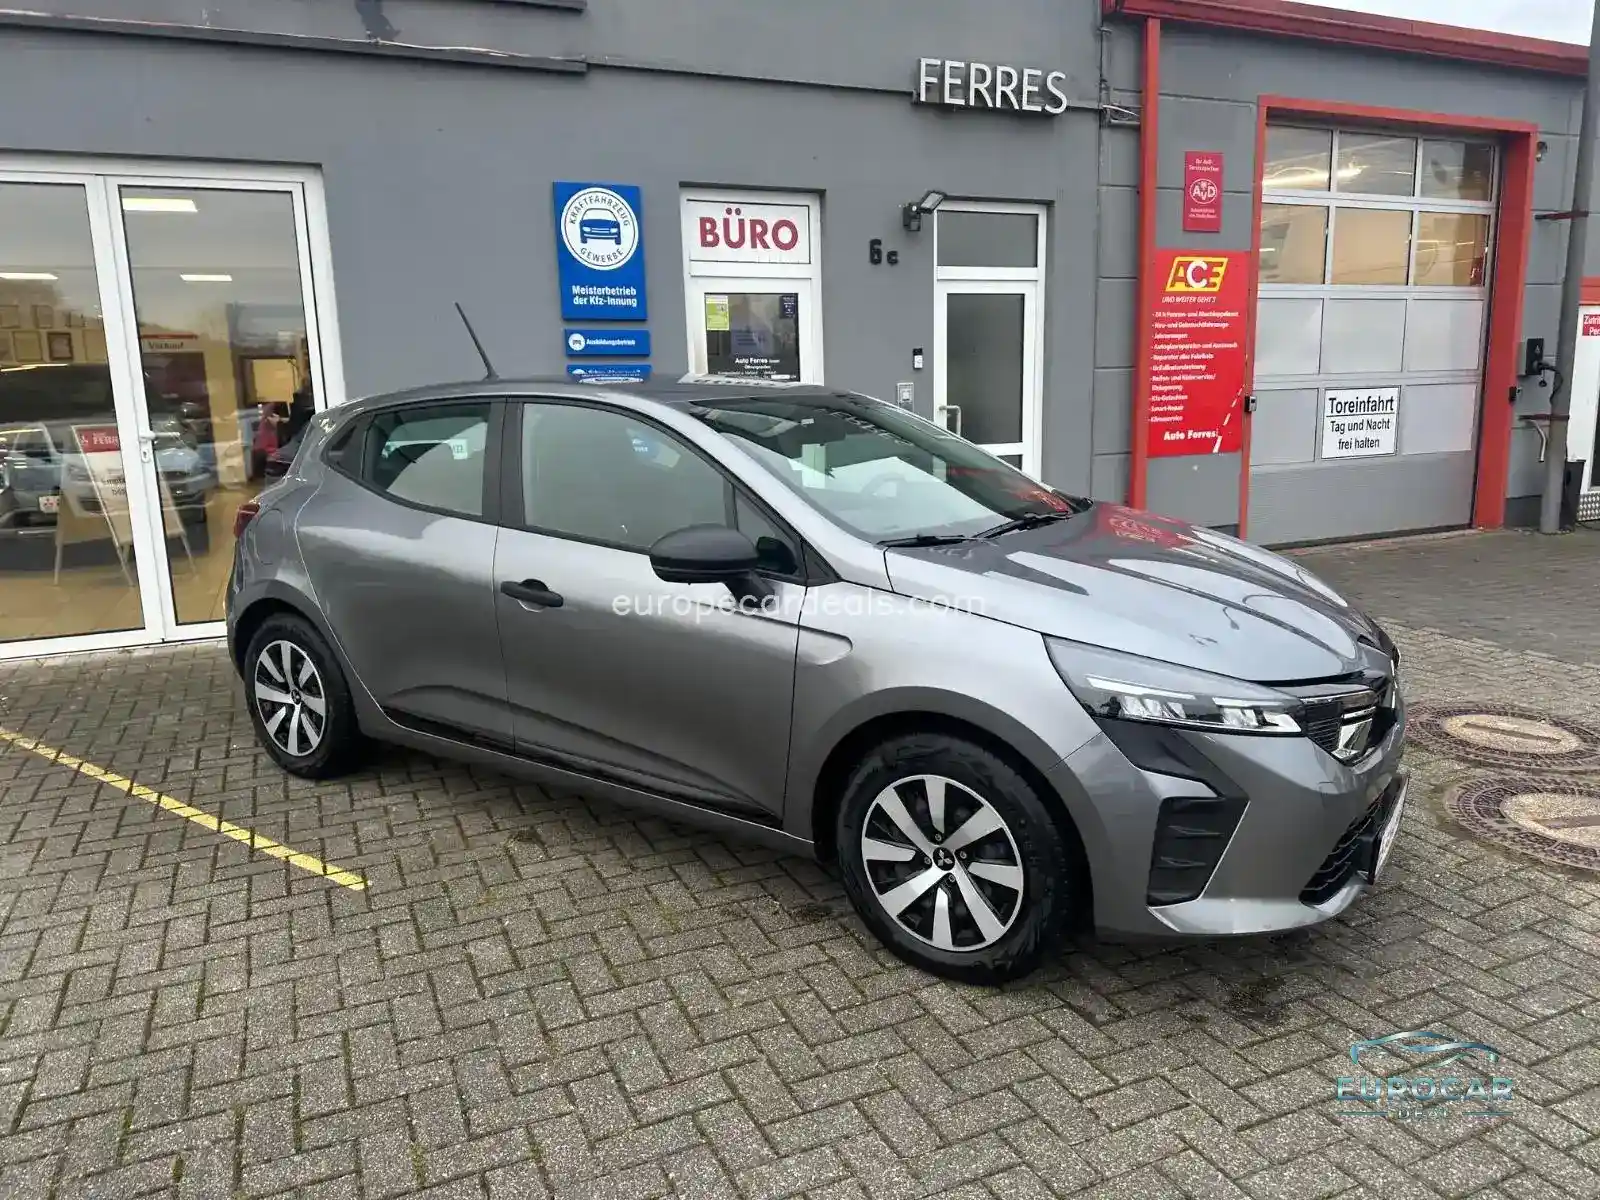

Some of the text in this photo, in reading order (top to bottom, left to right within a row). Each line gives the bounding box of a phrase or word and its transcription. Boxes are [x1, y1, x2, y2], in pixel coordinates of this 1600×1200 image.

[919, 57, 1068, 114] FERRES
[570, 195, 630, 226] KRAFTFAHRZEUG
[699, 207, 799, 251] BÜRO
[580, 247, 624, 263] GEWERBE
[1168, 259, 1224, 289] ACE
[571, 284, 637, 296] Meisterbetrieb
[573, 295, 638, 308] der Kfz-Innung
[1328, 395, 1395, 414] Toreinfahrt
[1330, 417, 1391, 435] Tag und Nacht
[1164, 430, 1217, 441] Auto Ferres
[1338, 436, 1380, 450] frei halten
